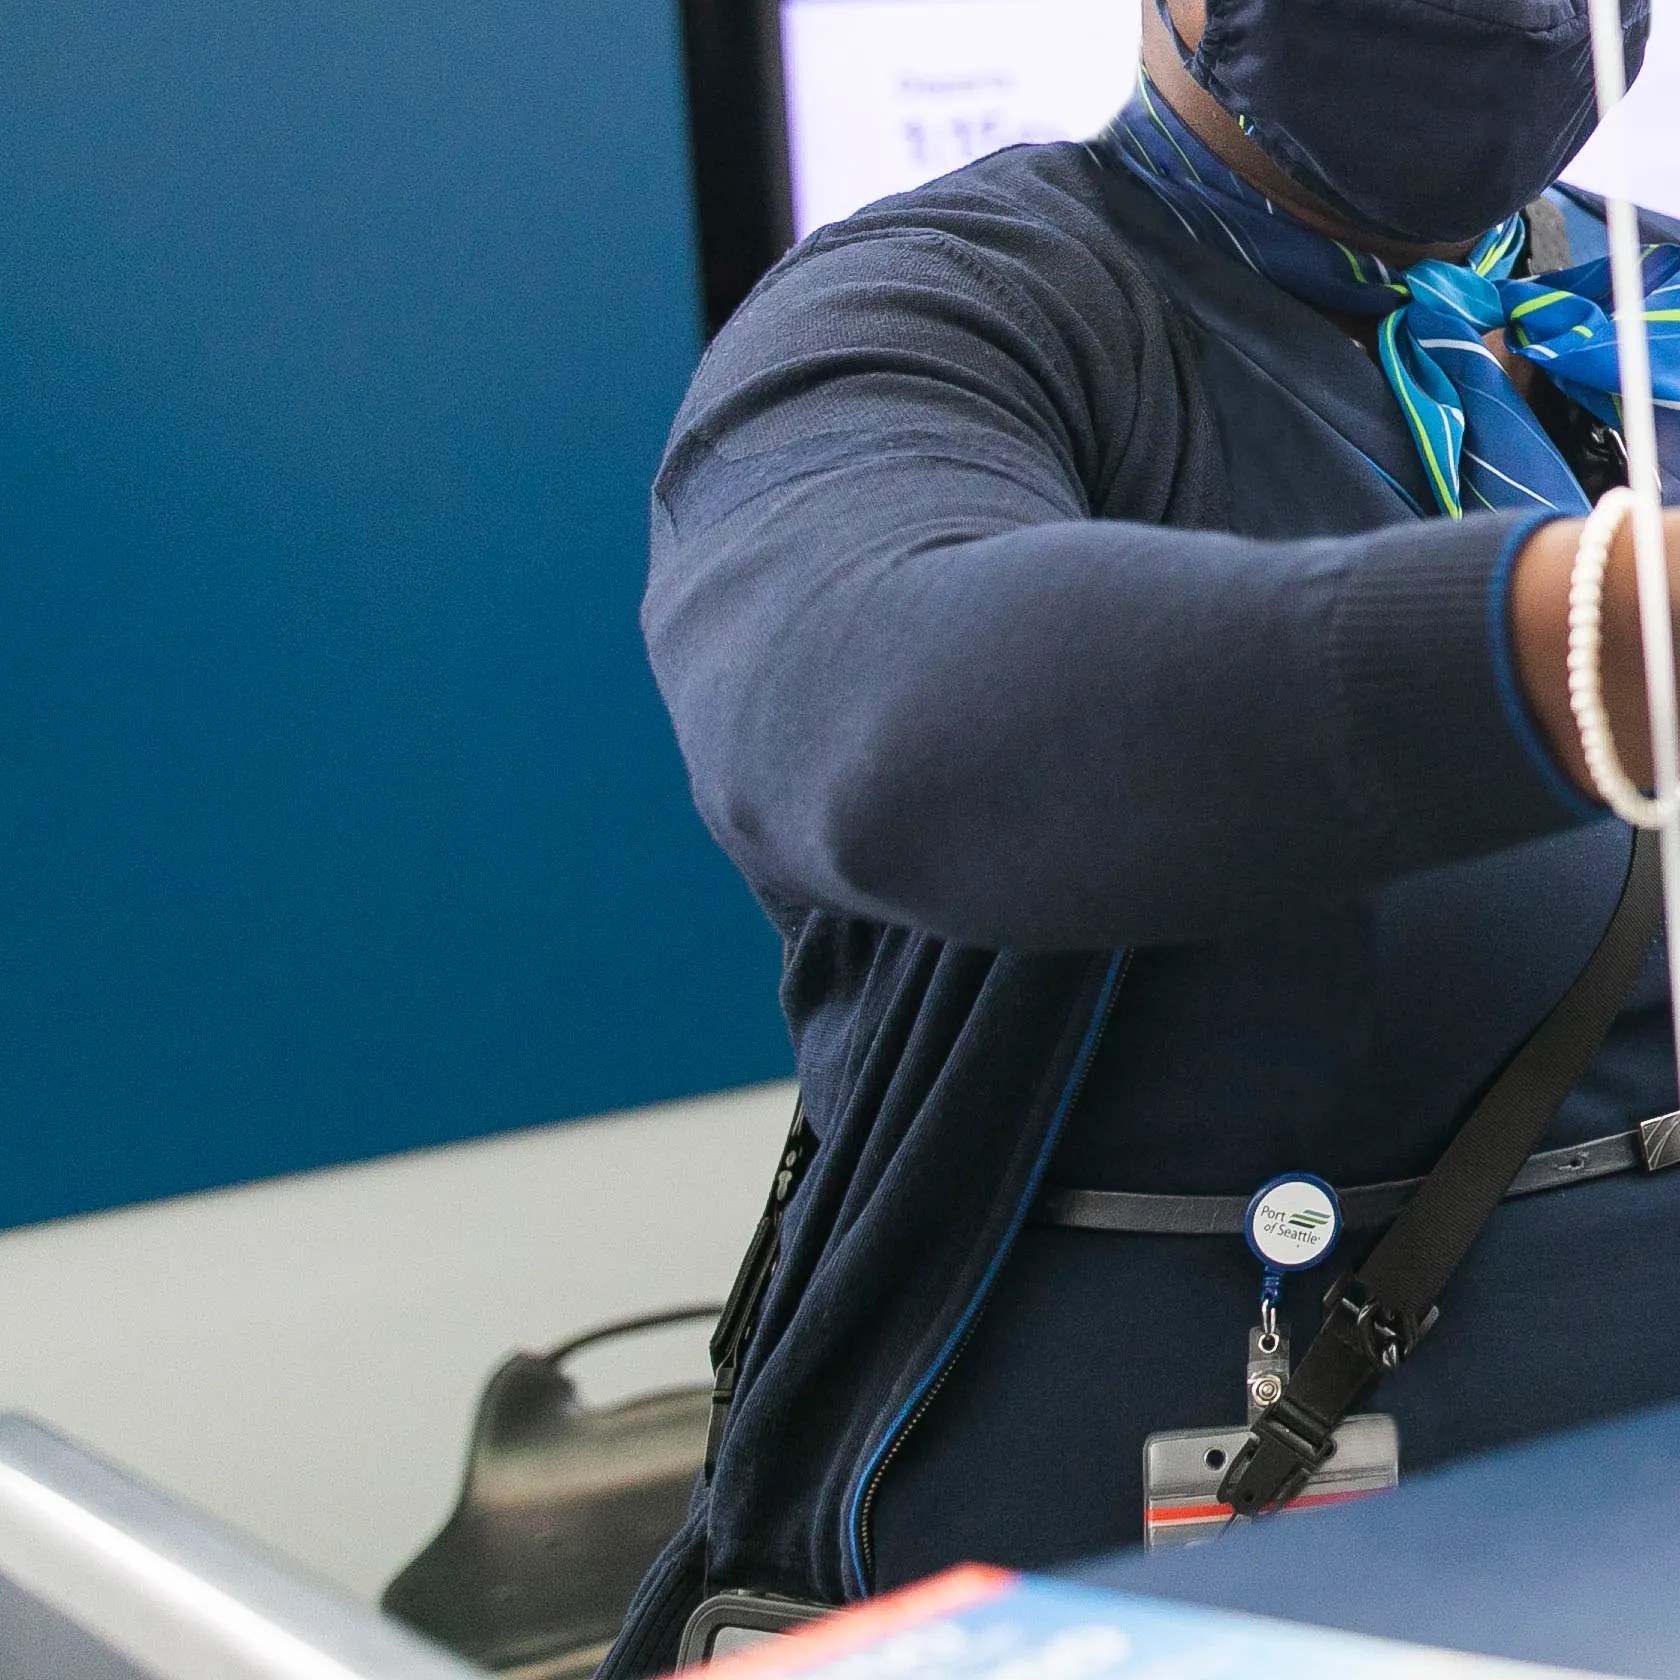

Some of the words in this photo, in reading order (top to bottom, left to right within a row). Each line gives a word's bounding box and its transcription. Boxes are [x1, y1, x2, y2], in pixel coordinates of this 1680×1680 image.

[1260, 1205, 1286, 1222] Port
[1264, 1222, 1278, 1234] of
[1277, 1224, 1318, 1245] Seattle
